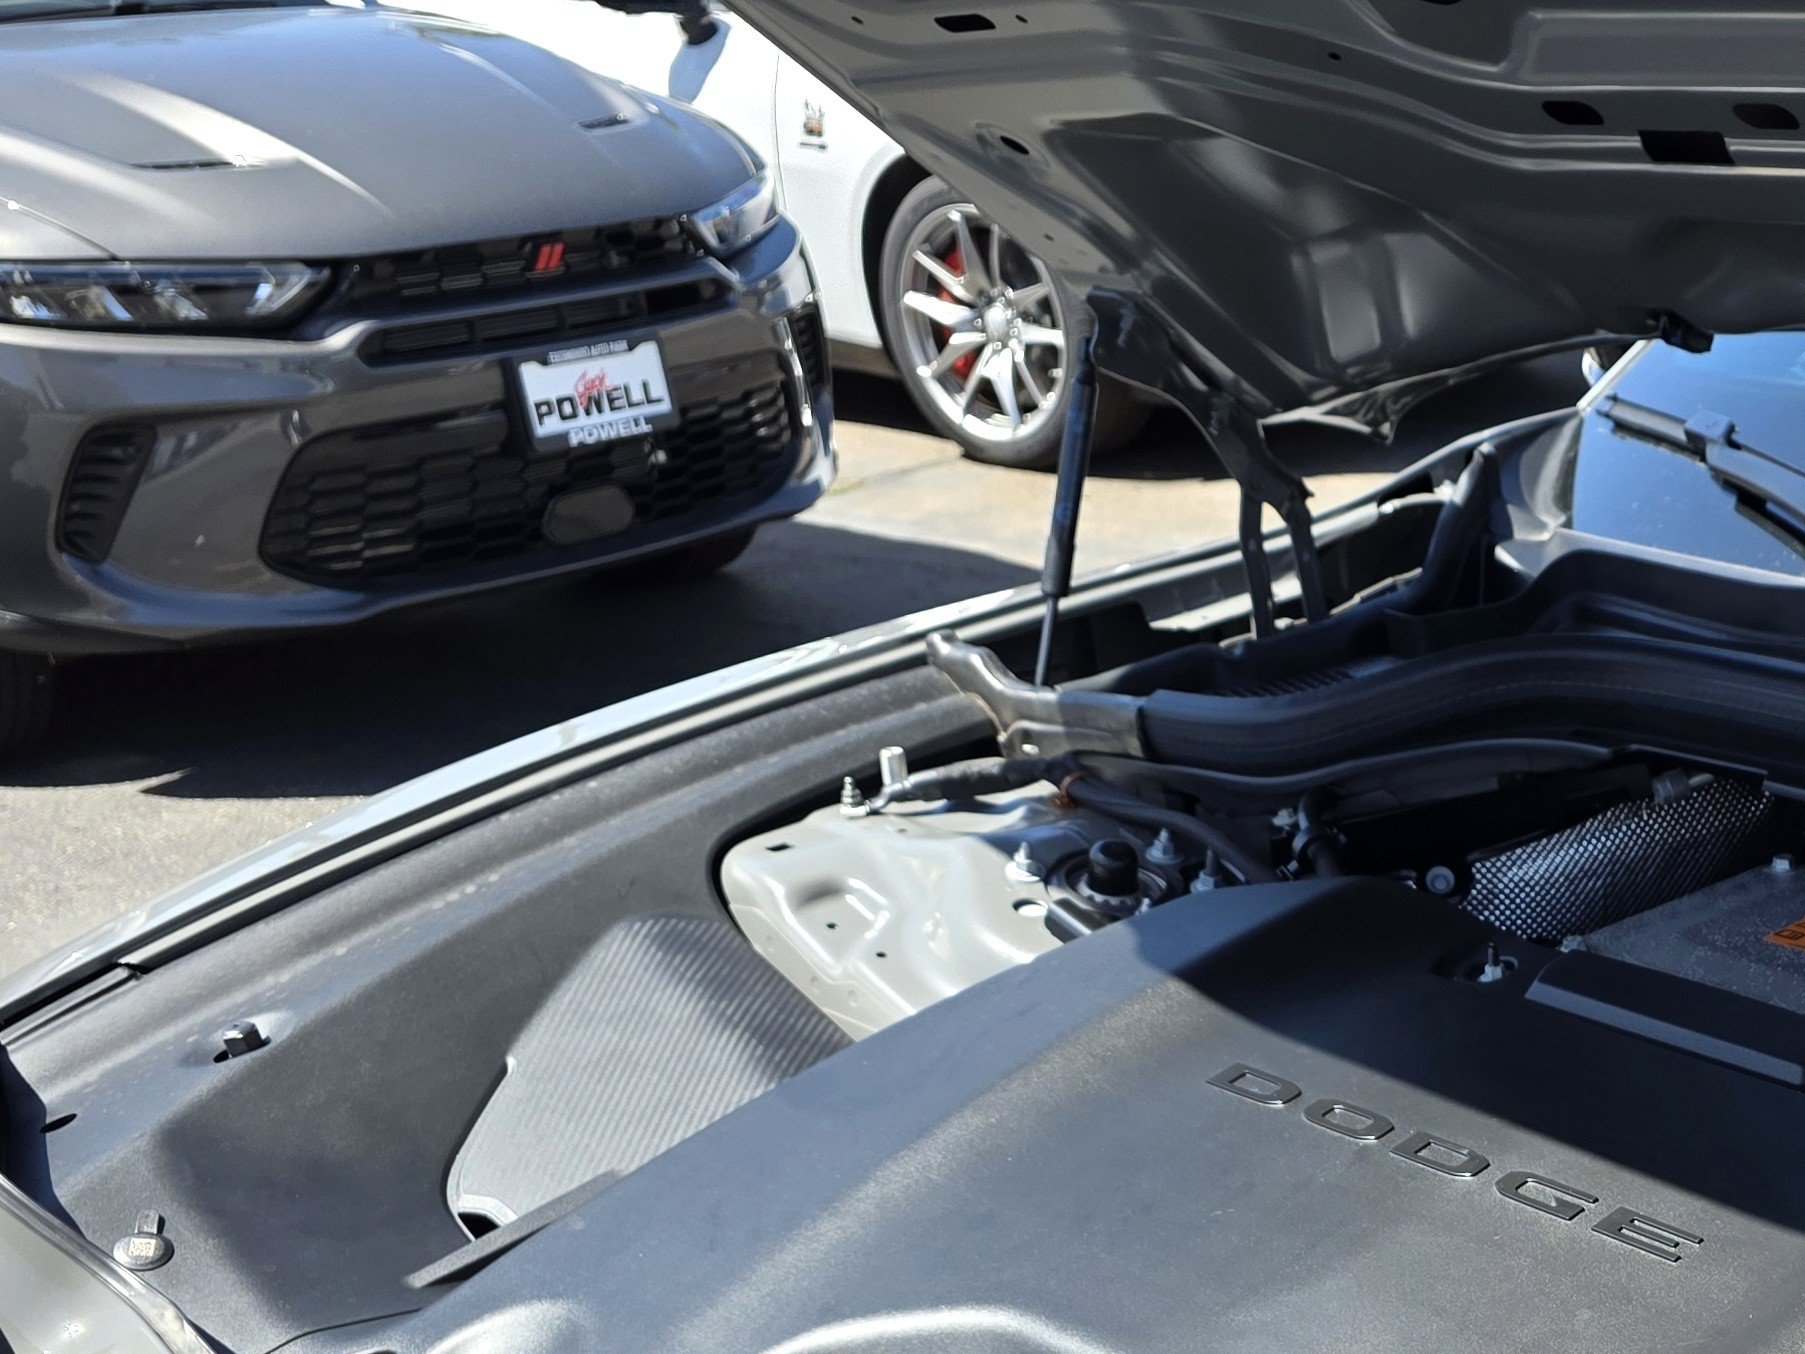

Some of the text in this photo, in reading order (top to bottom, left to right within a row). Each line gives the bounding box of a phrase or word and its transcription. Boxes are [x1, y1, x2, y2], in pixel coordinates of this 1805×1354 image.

[533, 379, 664, 426] POWELL
[567, 415, 653, 447] POWELL
[1206, 1063, 1704, 1263] DODGE
